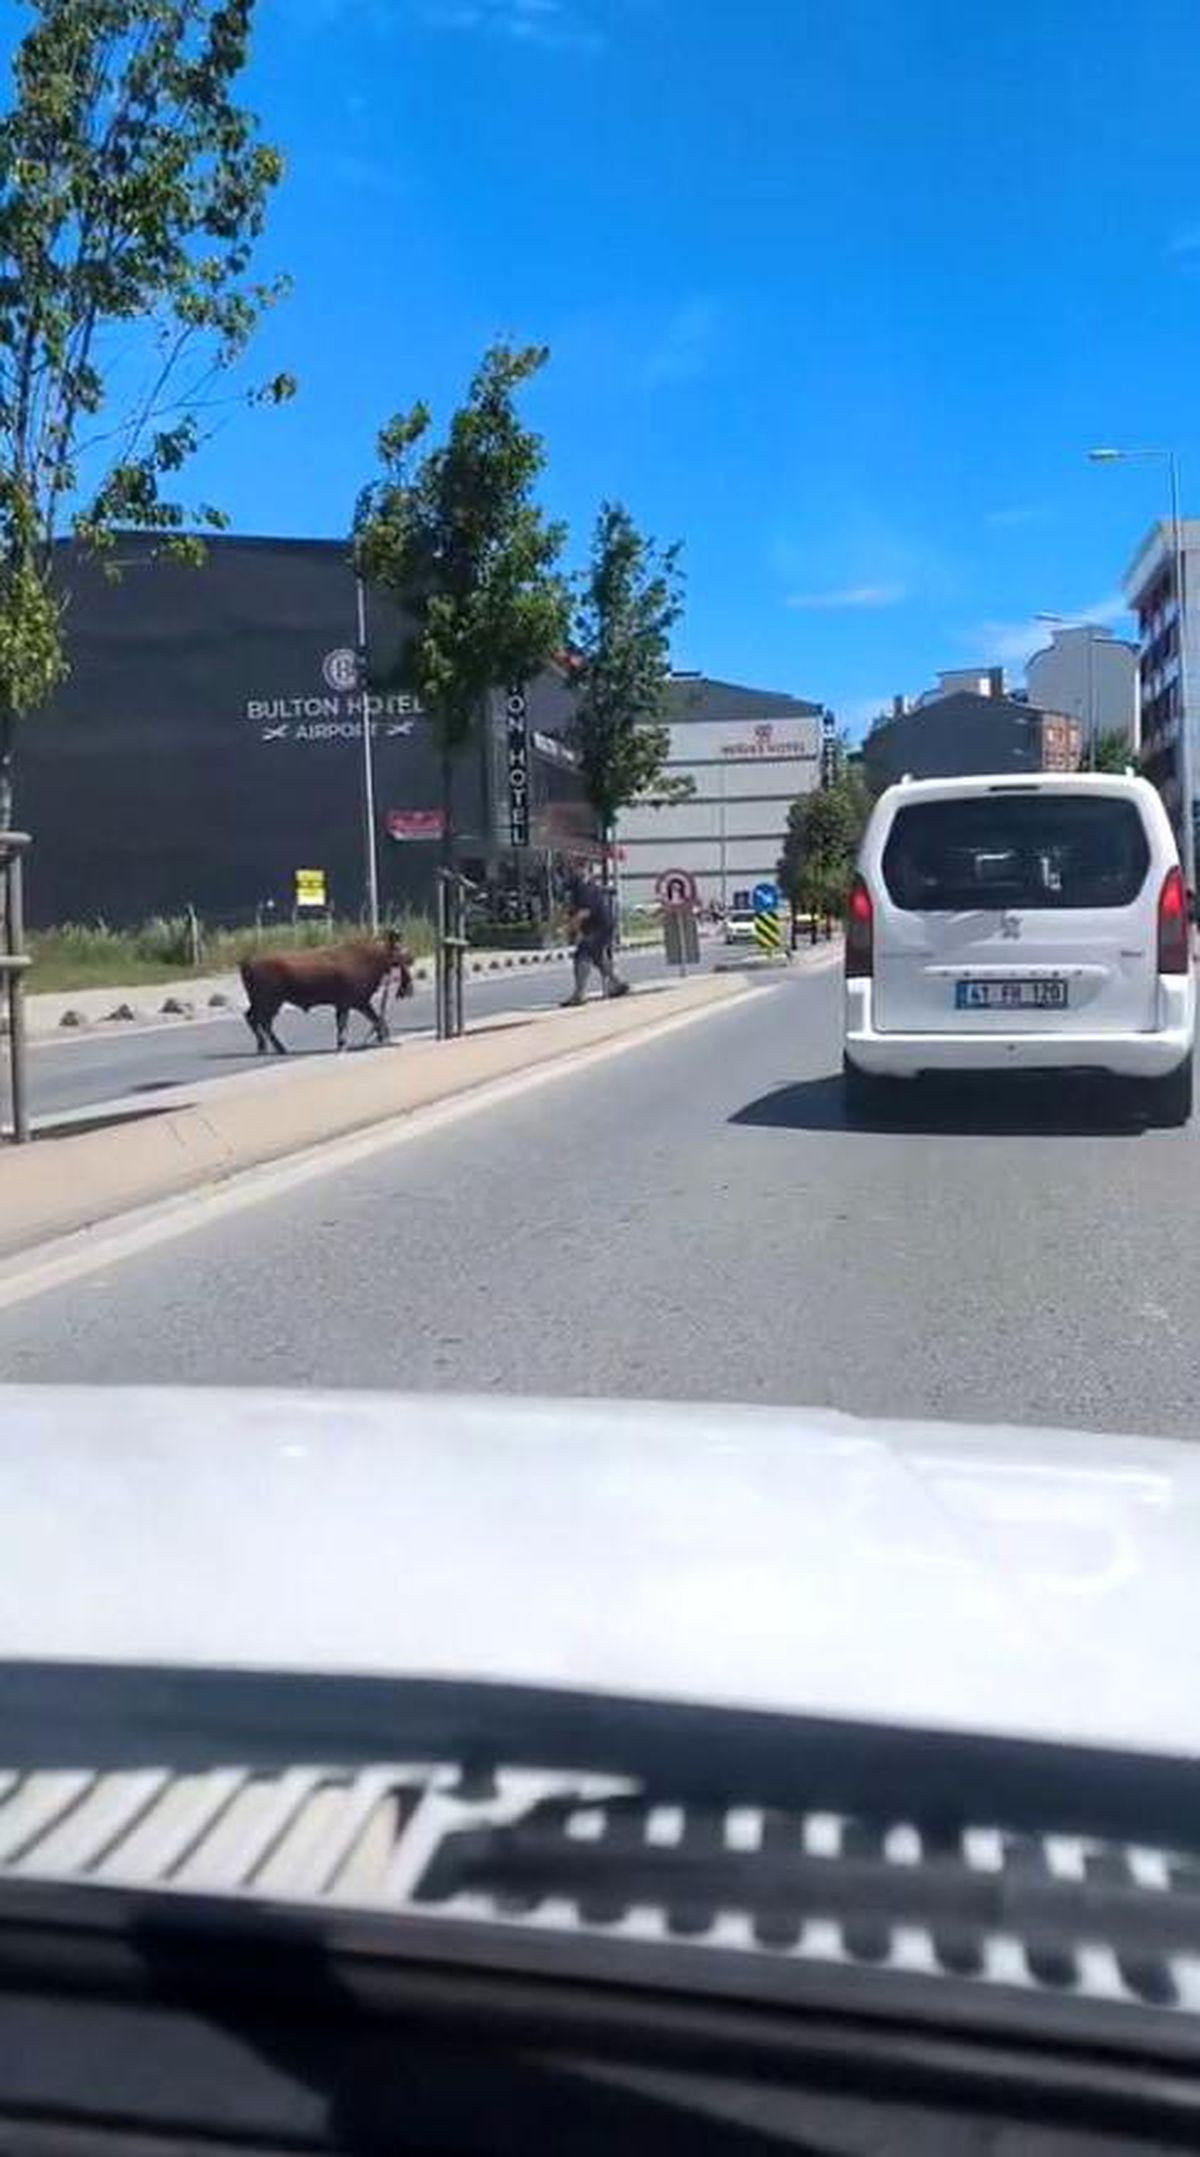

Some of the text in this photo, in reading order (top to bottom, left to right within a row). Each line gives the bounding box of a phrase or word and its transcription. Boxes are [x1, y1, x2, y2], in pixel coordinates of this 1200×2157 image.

[246, 694, 425, 720] BULTON HOTEL
[510, 749, 526, 844] HOTEL
